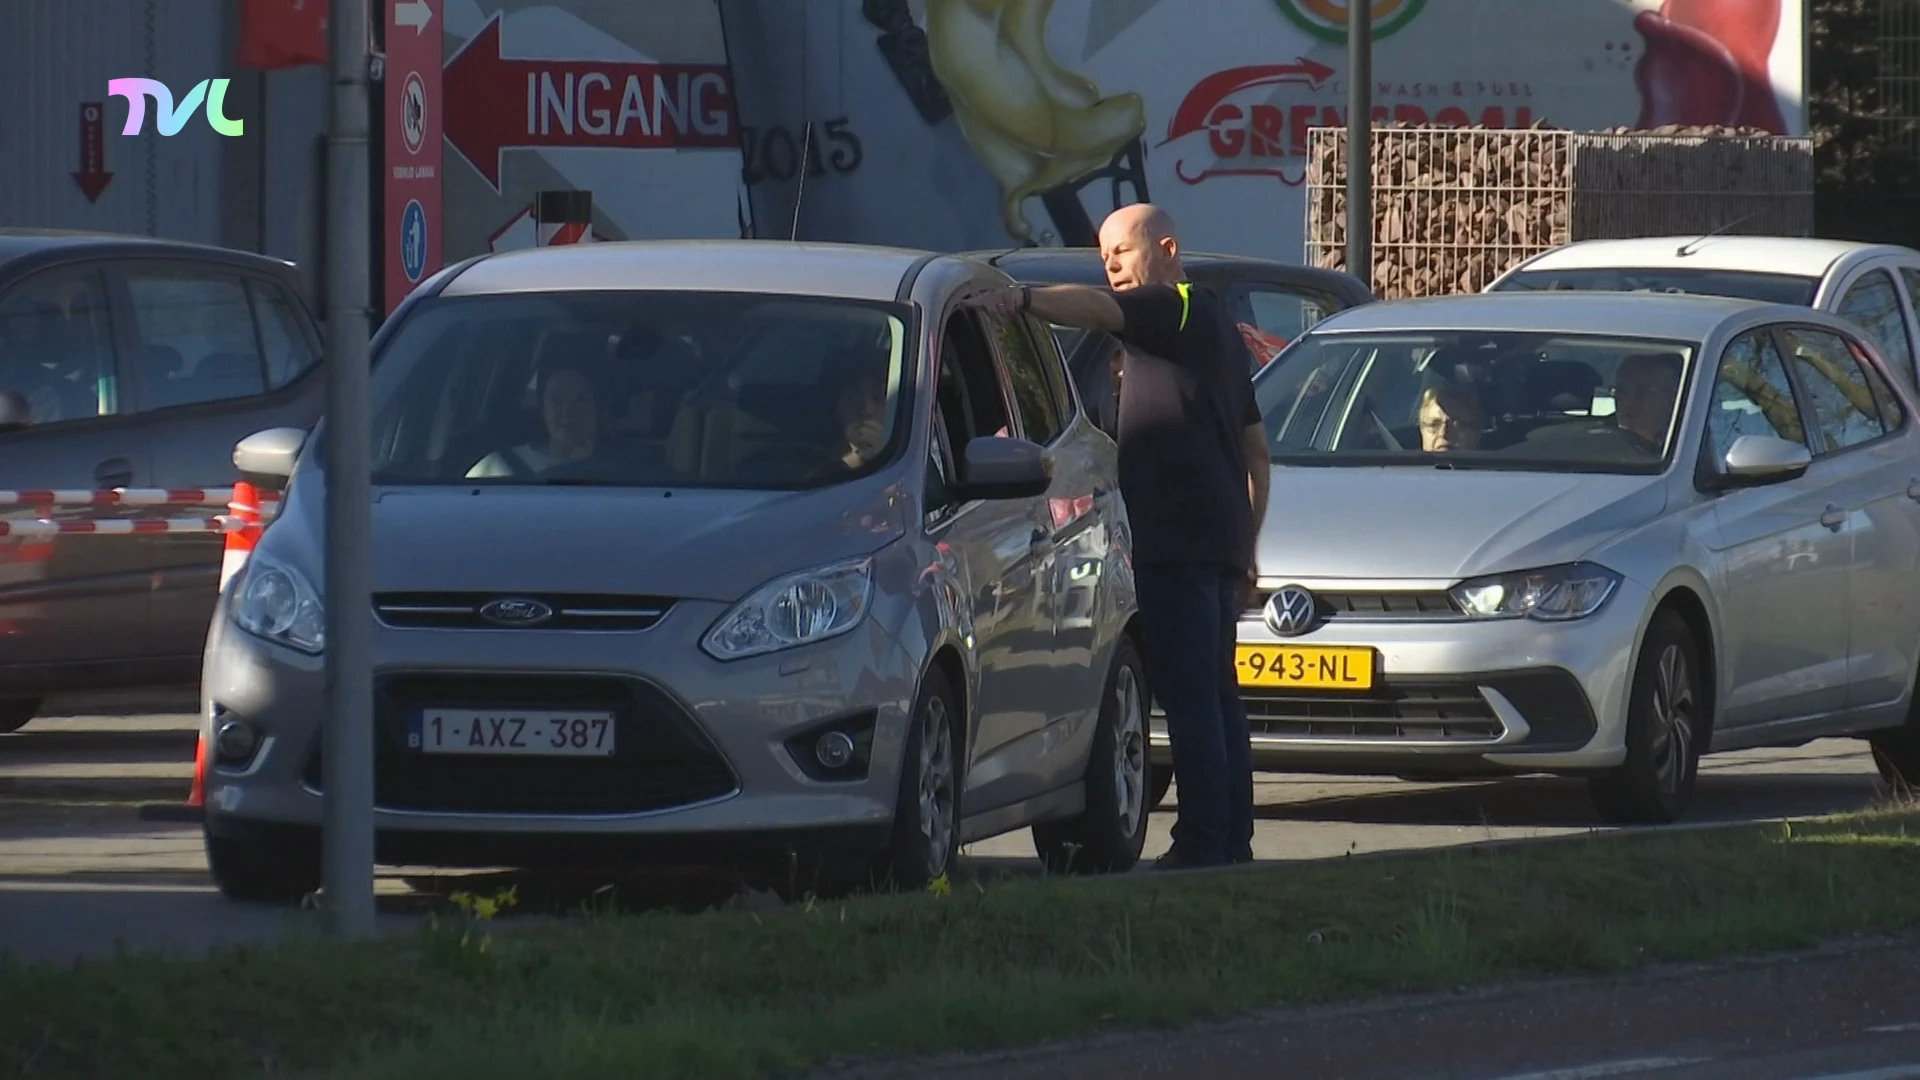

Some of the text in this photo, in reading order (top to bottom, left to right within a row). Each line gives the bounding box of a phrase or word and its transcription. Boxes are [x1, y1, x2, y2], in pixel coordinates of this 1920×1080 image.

[526, 71, 729, 136] INGANG
[1378, 81, 1438, 98] WASH
[739, 116, 864, 186] 2015
[1238, 652, 1358, 682] -943-NL
[430, 716, 609, 749] 1-AXZ-387
